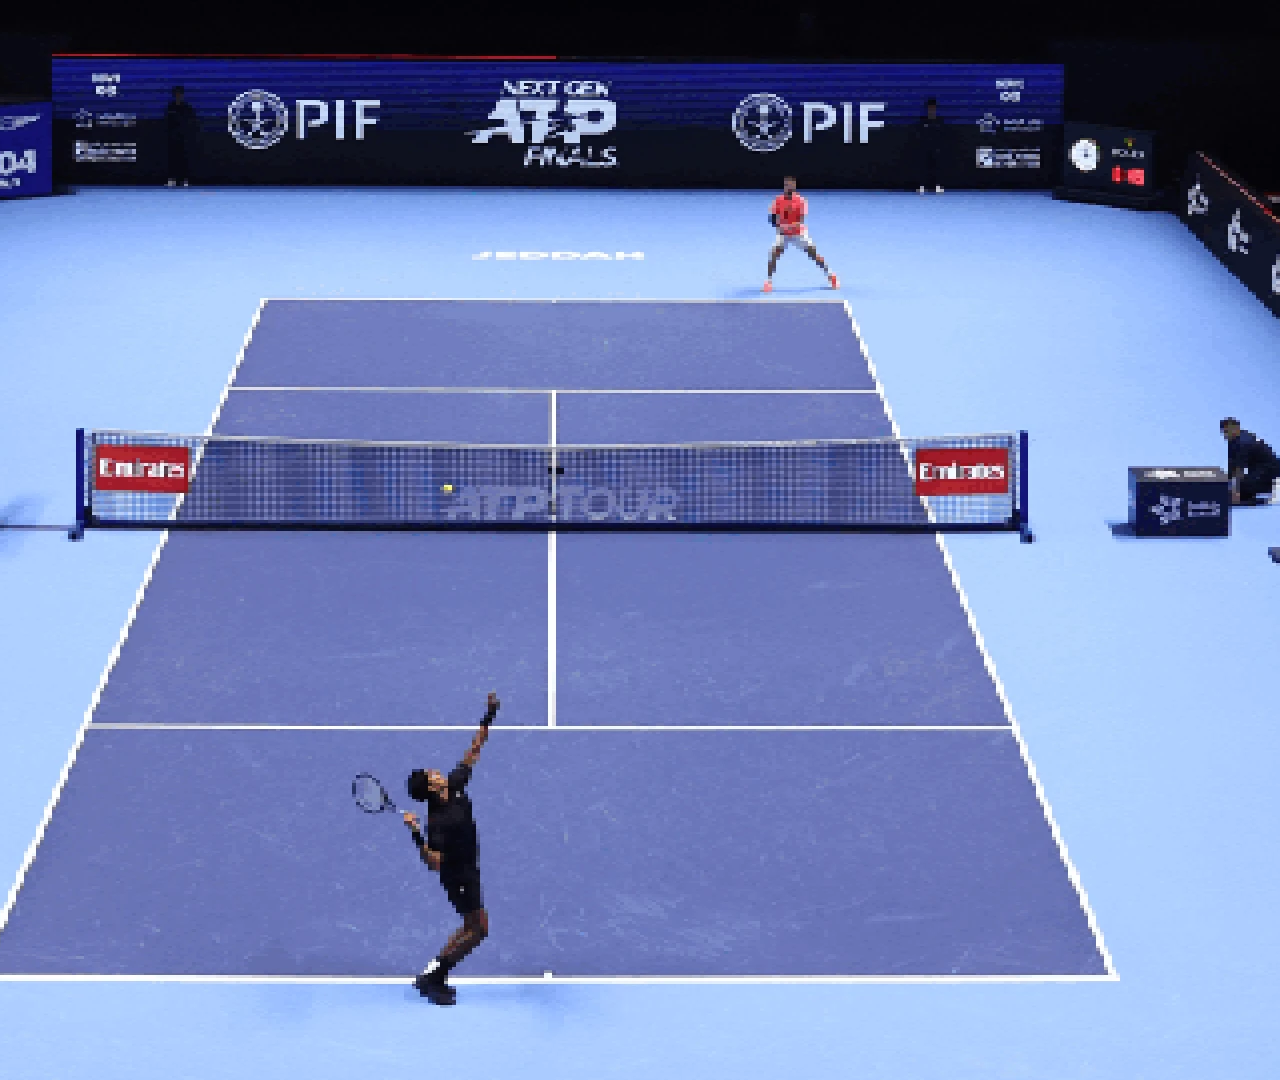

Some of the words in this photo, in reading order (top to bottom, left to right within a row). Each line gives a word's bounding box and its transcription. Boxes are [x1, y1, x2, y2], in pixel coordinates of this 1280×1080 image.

[502, 80, 561, 96] NEXT
[563, 80, 612, 96] GEN
[295, 98, 381, 140] PIF
[464, 99, 616, 144] ATP
[801, 101, 888, 144] PIF
[524, 145, 620, 168] FINALS
[472, 251, 645, 261] JEDDAH
[99, 457, 184, 477] Emirates
[919, 459, 1007, 481] Emirates
[441, 485, 549, 521] ATP
[555, 485, 678, 521] TOUR
